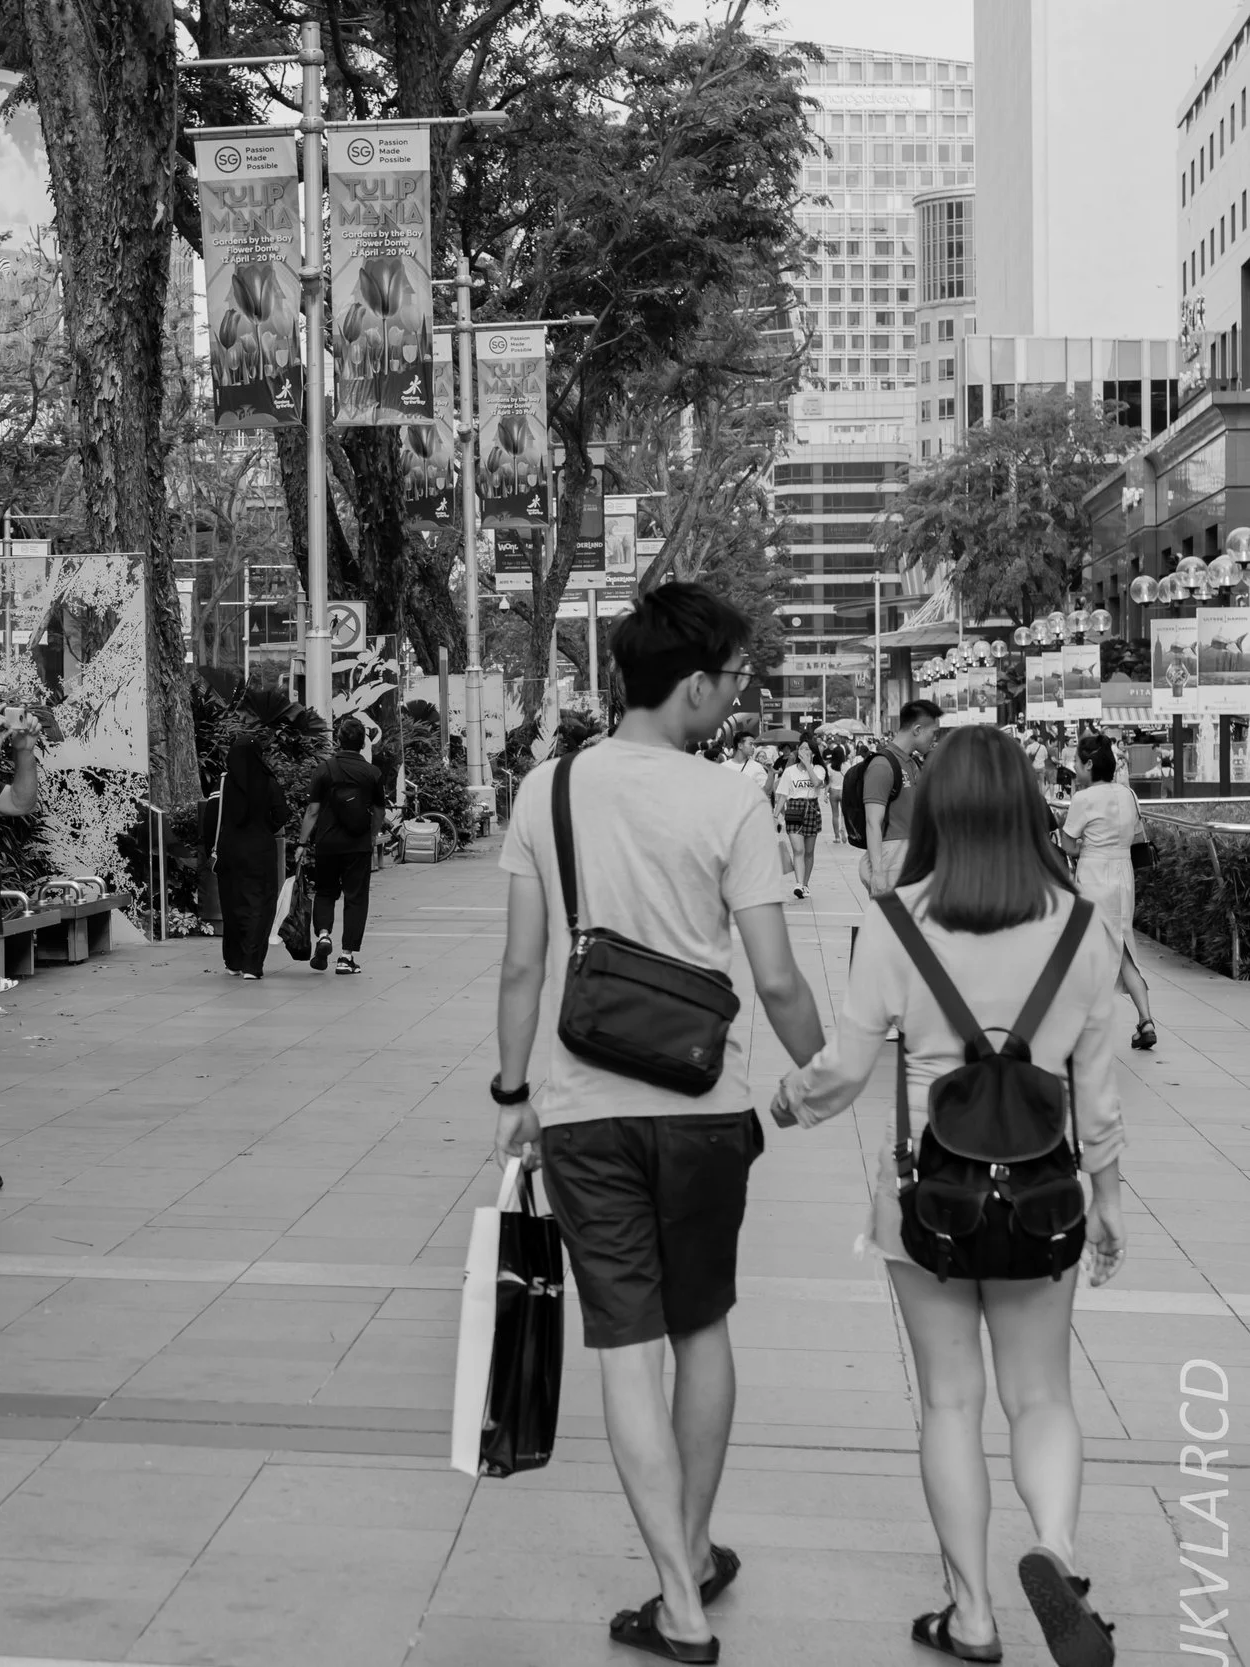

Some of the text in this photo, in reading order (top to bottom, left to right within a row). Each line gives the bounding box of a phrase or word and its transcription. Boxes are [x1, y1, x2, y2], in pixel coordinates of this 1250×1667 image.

[351, 146, 372, 158] SG
[218, 154, 239, 166] SG
[213, 183, 284, 208] TULIP
[344, 177, 417, 202] TULIP
[209, 207, 293, 234] MANIA
[339, 202, 423, 226] MANIA
[213, 233, 294, 247] Gardens by the Bay
[341, 228, 423, 240] Gardens by the Bay
[226, 244, 280, 255] Flower Dome
[355, 238, 409, 248] Flower Dome
[230, 254, 250, 266] April
[257, 254, 268, 263] 20
[269, 253, 287, 263] May
[350, 249, 358, 258] 12
[358, 248, 379, 259] April
[386, 248, 397, 257] 20
[398, 247, 417, 258] May
[491, 341, 505, 349] SG
[488, 361, 538, 380] TULIP
[483, 379, 542, 396] MANIA
